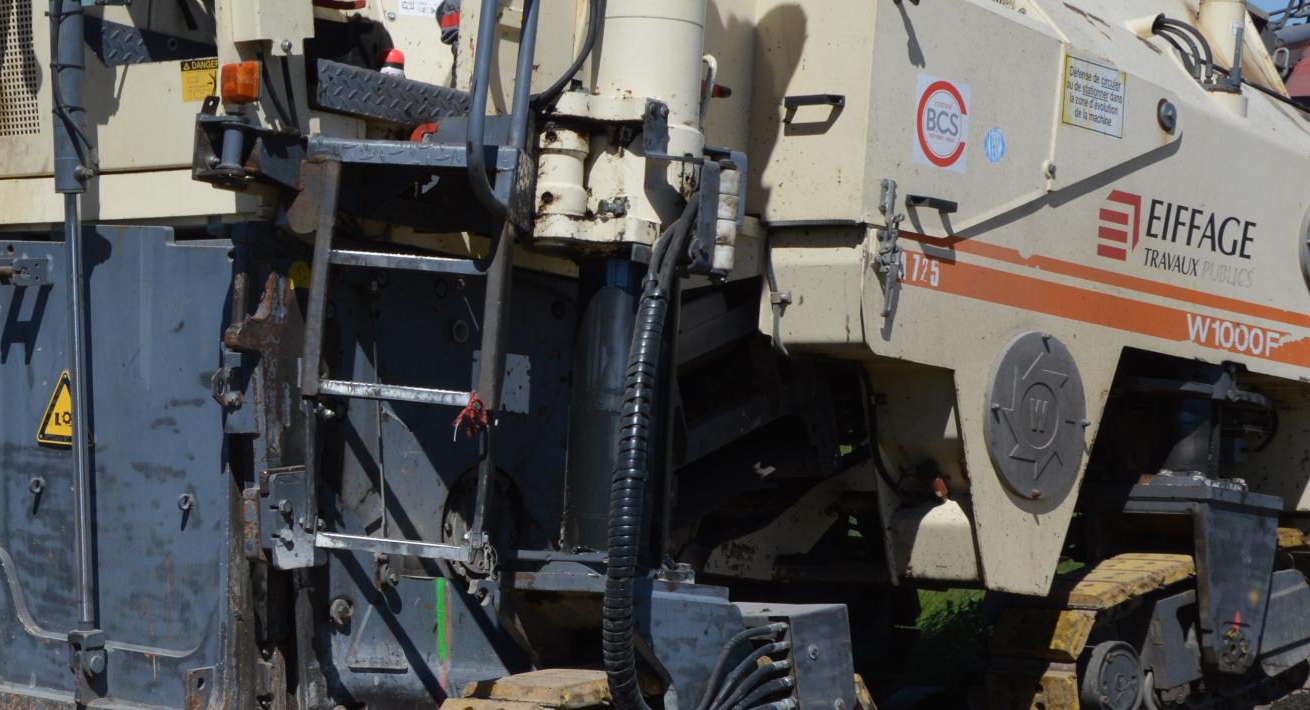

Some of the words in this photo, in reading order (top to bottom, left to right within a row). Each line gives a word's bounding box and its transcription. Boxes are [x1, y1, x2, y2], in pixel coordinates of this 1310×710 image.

[1070, 66, 1092, 81] Défense
[1093, 73, 1100, 84] de
[1101, 75, 1121, 90] circuler
[1067, 81, 1073, 90] ou
[1074, 81, 1081, 92] de
[1083, 84, 1109, 99] stationner
[1110, 91, 1123, 104] dans
[1070, 92, 1075, 103] la
[1075, 96, 1089, 107] zone
[1074, 108, 1082, 118] de
[1083, 108, 1088, 120] la
[1089, 113, 1112, 127] machine
[1146, 199, 1257, 260] EIFFAGE
[1144, 248, 1200, 277] TRAVAUX
